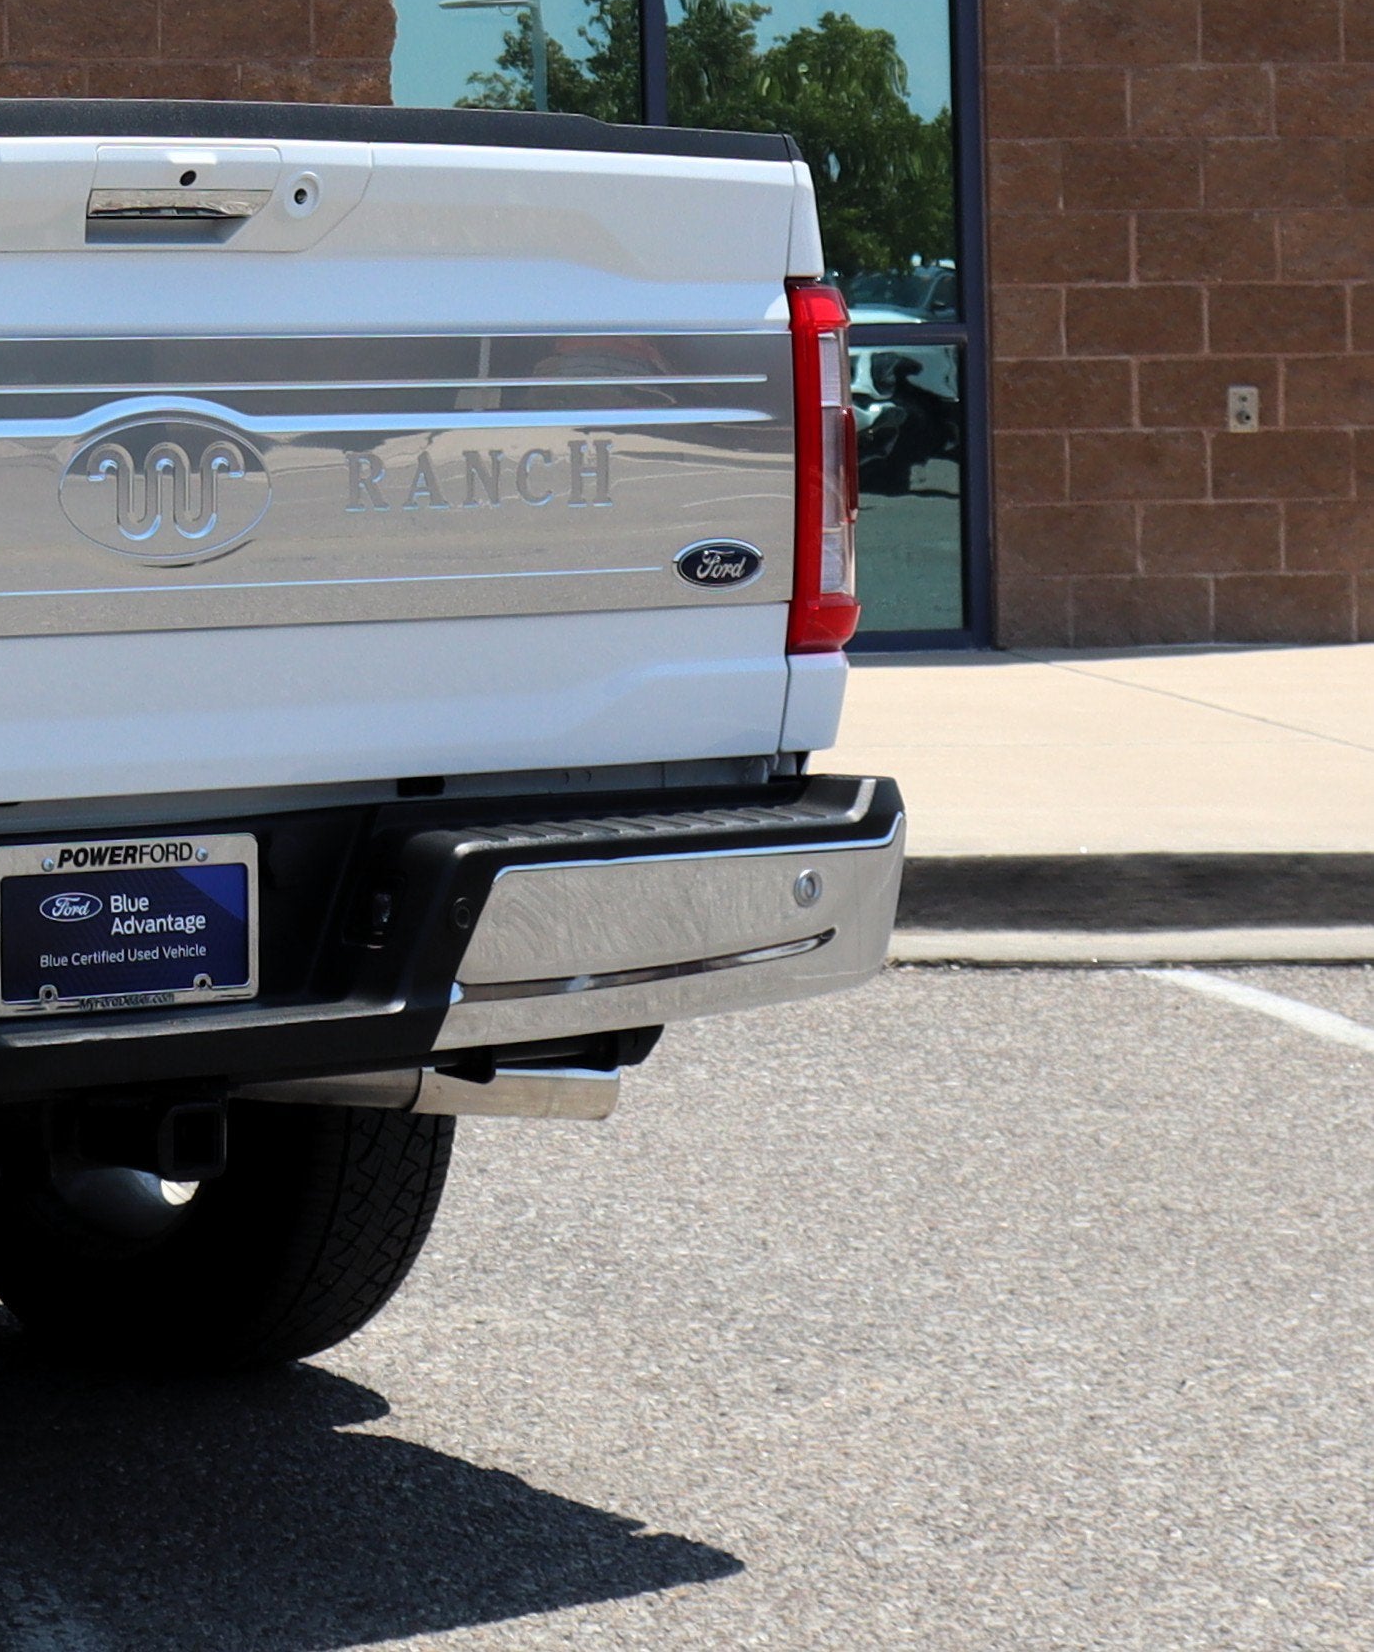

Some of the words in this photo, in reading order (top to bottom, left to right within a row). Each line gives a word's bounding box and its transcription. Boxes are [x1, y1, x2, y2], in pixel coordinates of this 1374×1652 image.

[344, 438, 614, 512] RANCH
[696, 549, 748, 580] Ford
[57, 842, 193, 868] POWERFORD
[51, 896, 91, 918] Ford
[109, 894, 149, 914] Blue
[111, 913, 206, 936] Advantage
[39, 954, 69, 968] Blue
[70, 949, 125, 966] Certified
[127, 946, 160, 962] Used
[162, 943, 207, 959] Vehicle
